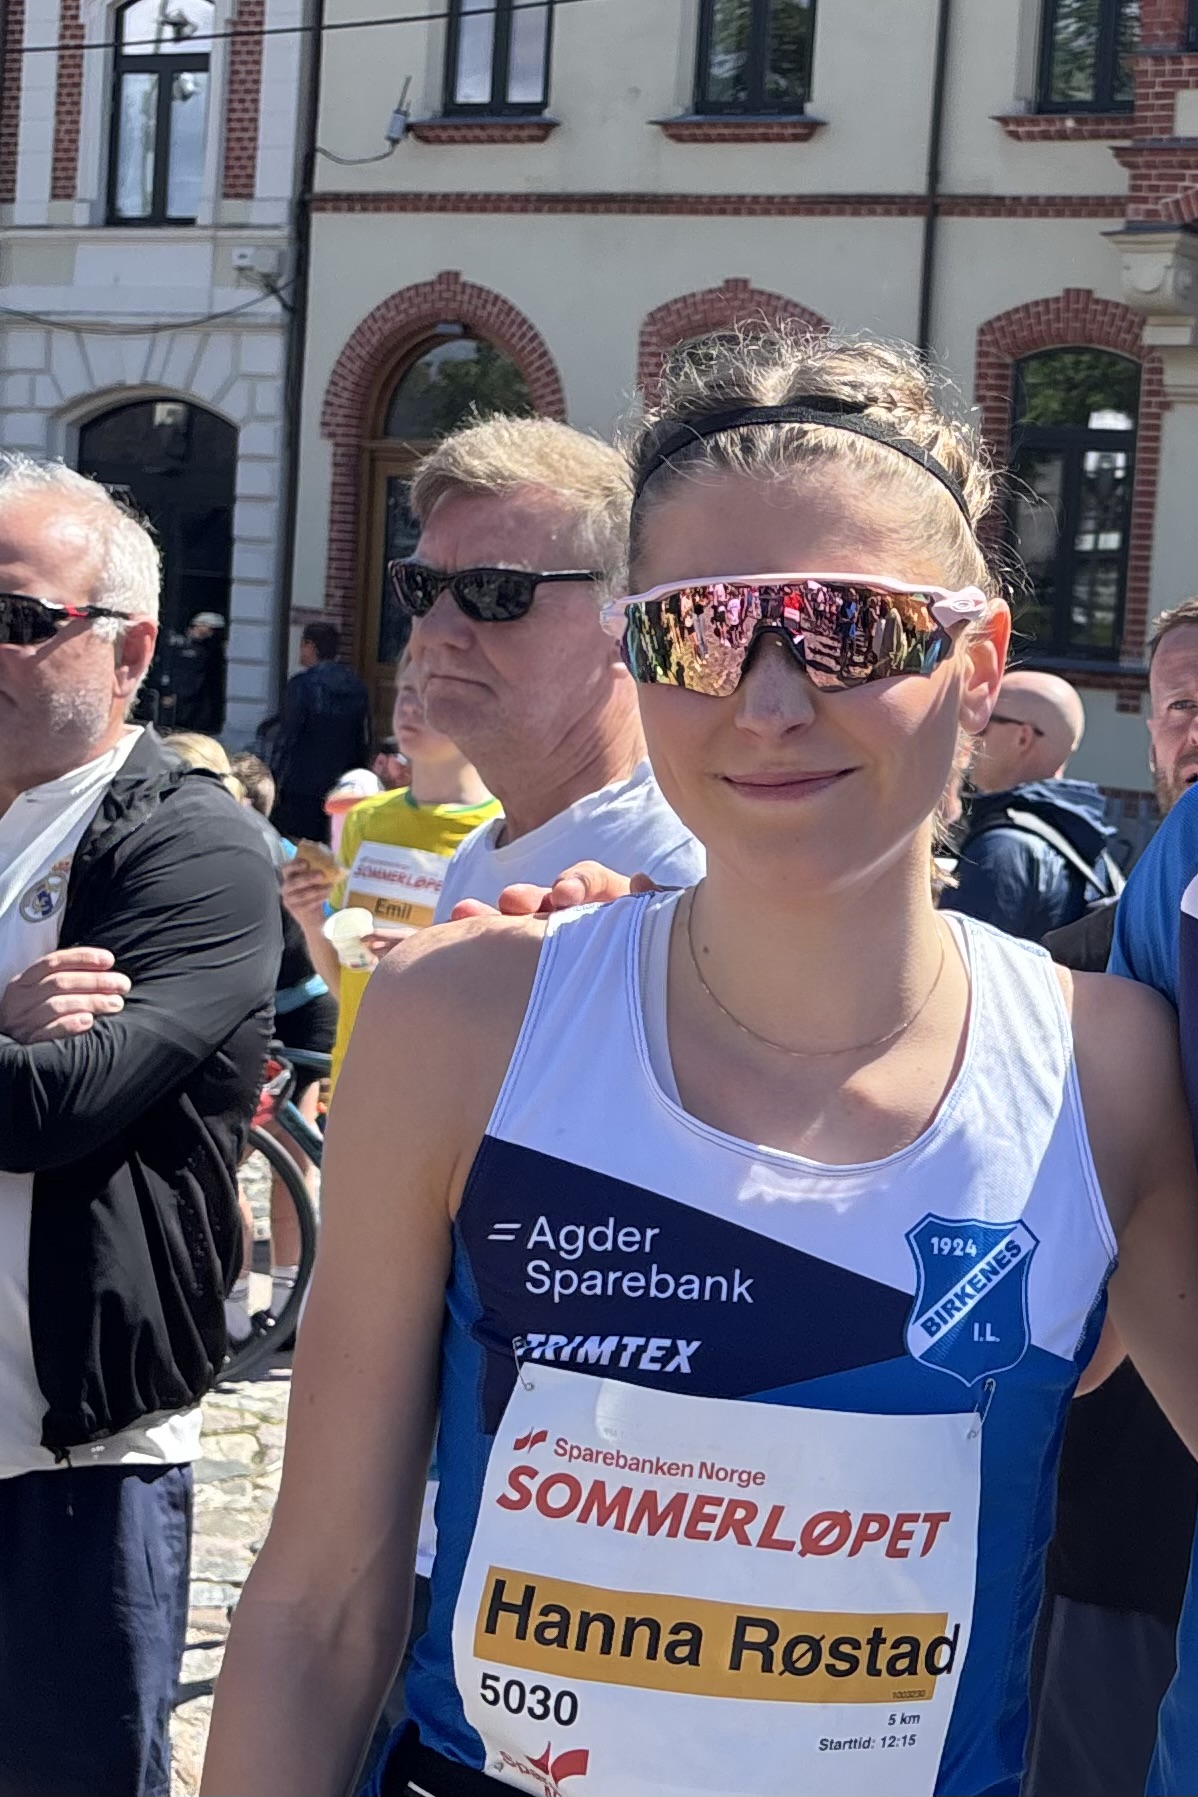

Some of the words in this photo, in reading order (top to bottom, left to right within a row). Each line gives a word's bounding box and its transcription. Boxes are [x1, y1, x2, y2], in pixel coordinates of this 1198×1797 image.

[353, 864, 443, 892] SOMMERLØPE
[375, 897, 412, 920] Emil
[527, 1216, 660, 1260] Agder
[930, 1236, 977, 1258] 1924
[525, 1260, 754, 1303] Sparebank
[920, 1239, 1022, 1338] BIRKENES
[516, 1333, 702, 1374] TRIMTEX
[554, 1437, 694, 1478] Sparebanken
[698, 1462, 766, 1488] Norge
[496, 1465, 951, 1559] SOMMERLØPET
[485, 1578, 703, 1667] Hanna
[729, 1616, 960, 1677] Røstad
[480, 1672, 578, 1726] 5030
[887, 1713, 897, 1726] 5
[900, 1713, 920, 1725] km
[819, 1737, 876, 1751] Starttid:
[881, 1734, 916, 1748] 12:15
